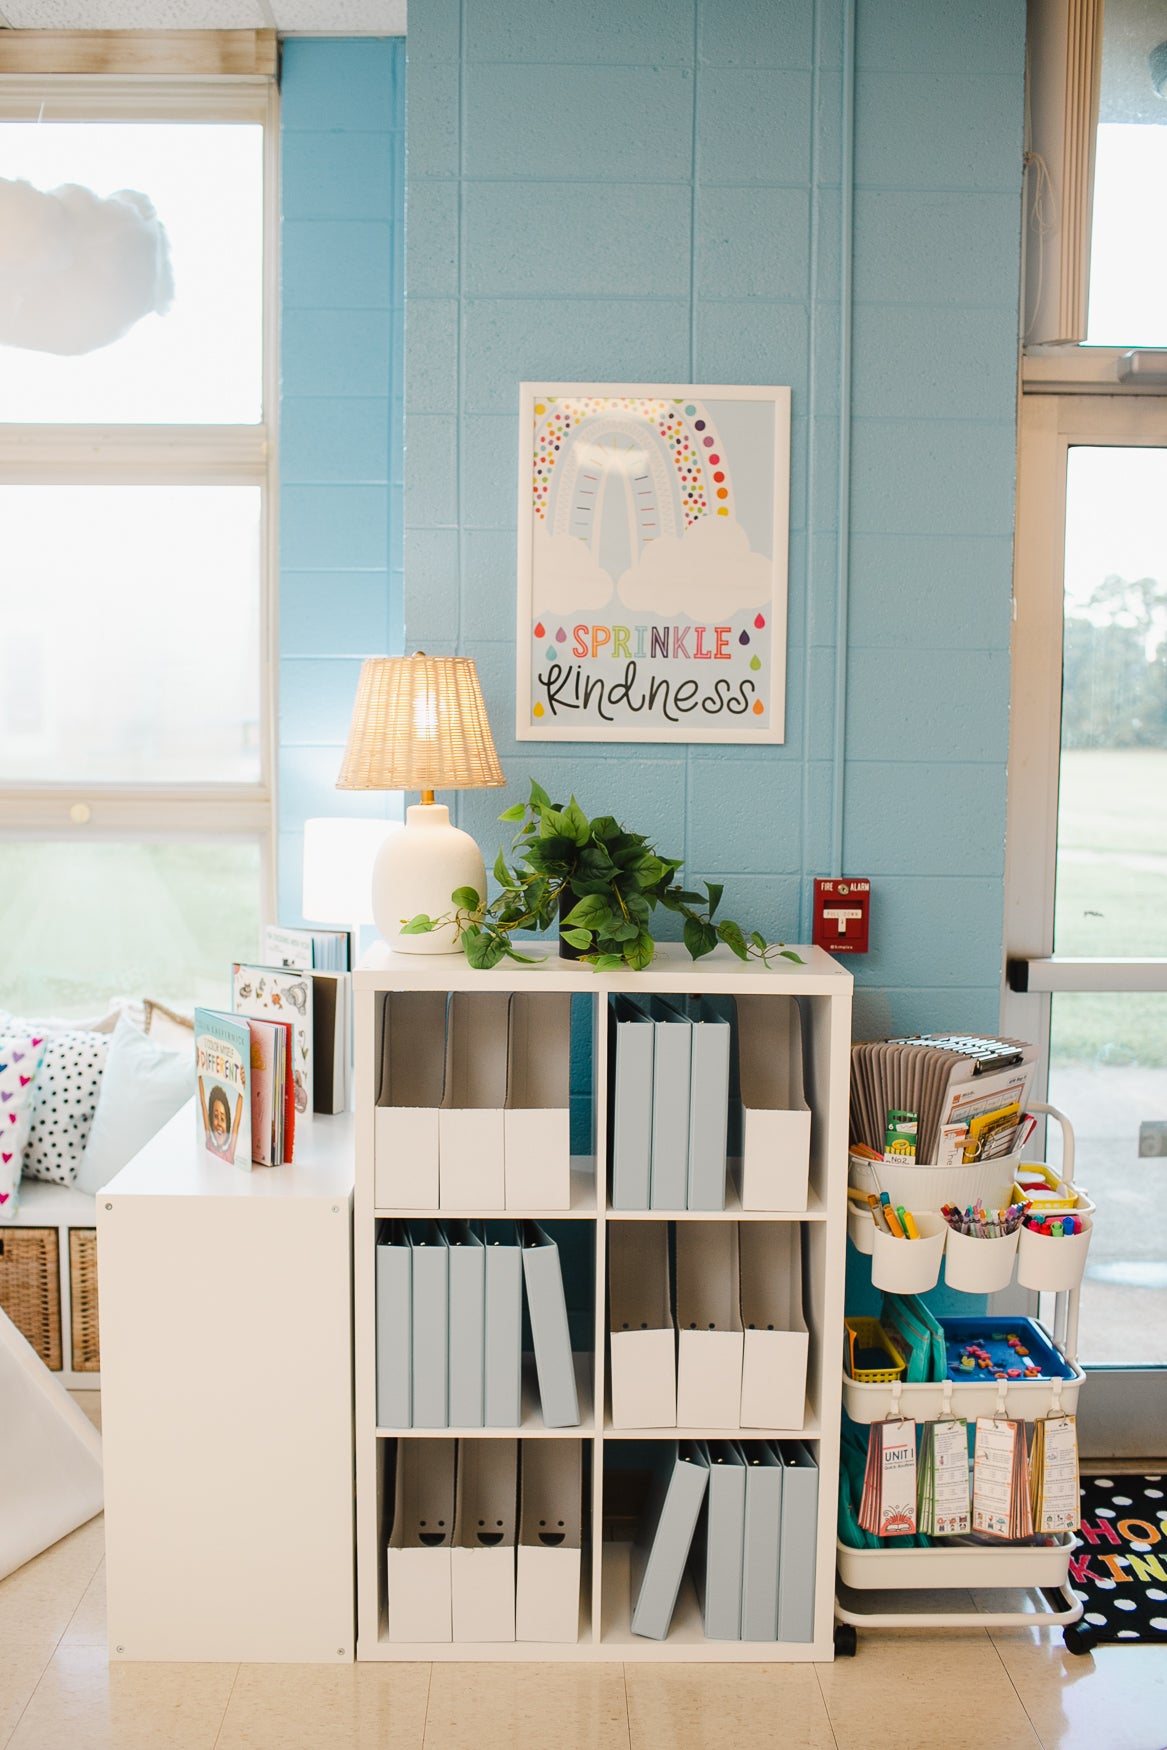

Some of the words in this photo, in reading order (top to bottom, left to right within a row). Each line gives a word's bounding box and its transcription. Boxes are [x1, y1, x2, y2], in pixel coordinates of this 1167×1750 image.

[572, 624, 732, 660] SPRINKLE
[538, 661, 755, 722] Kindness
[821, 882, 834, 891] FIRE
[850, 882, 870, 892] ALARM
[200, 1050, 240, 1083] DIFFERENT
[885, 1449, 908, 1462] UNIT
[1080, 1518, 1167, 1545] HO
[1068, 1554, 1167, 1583] KIN
